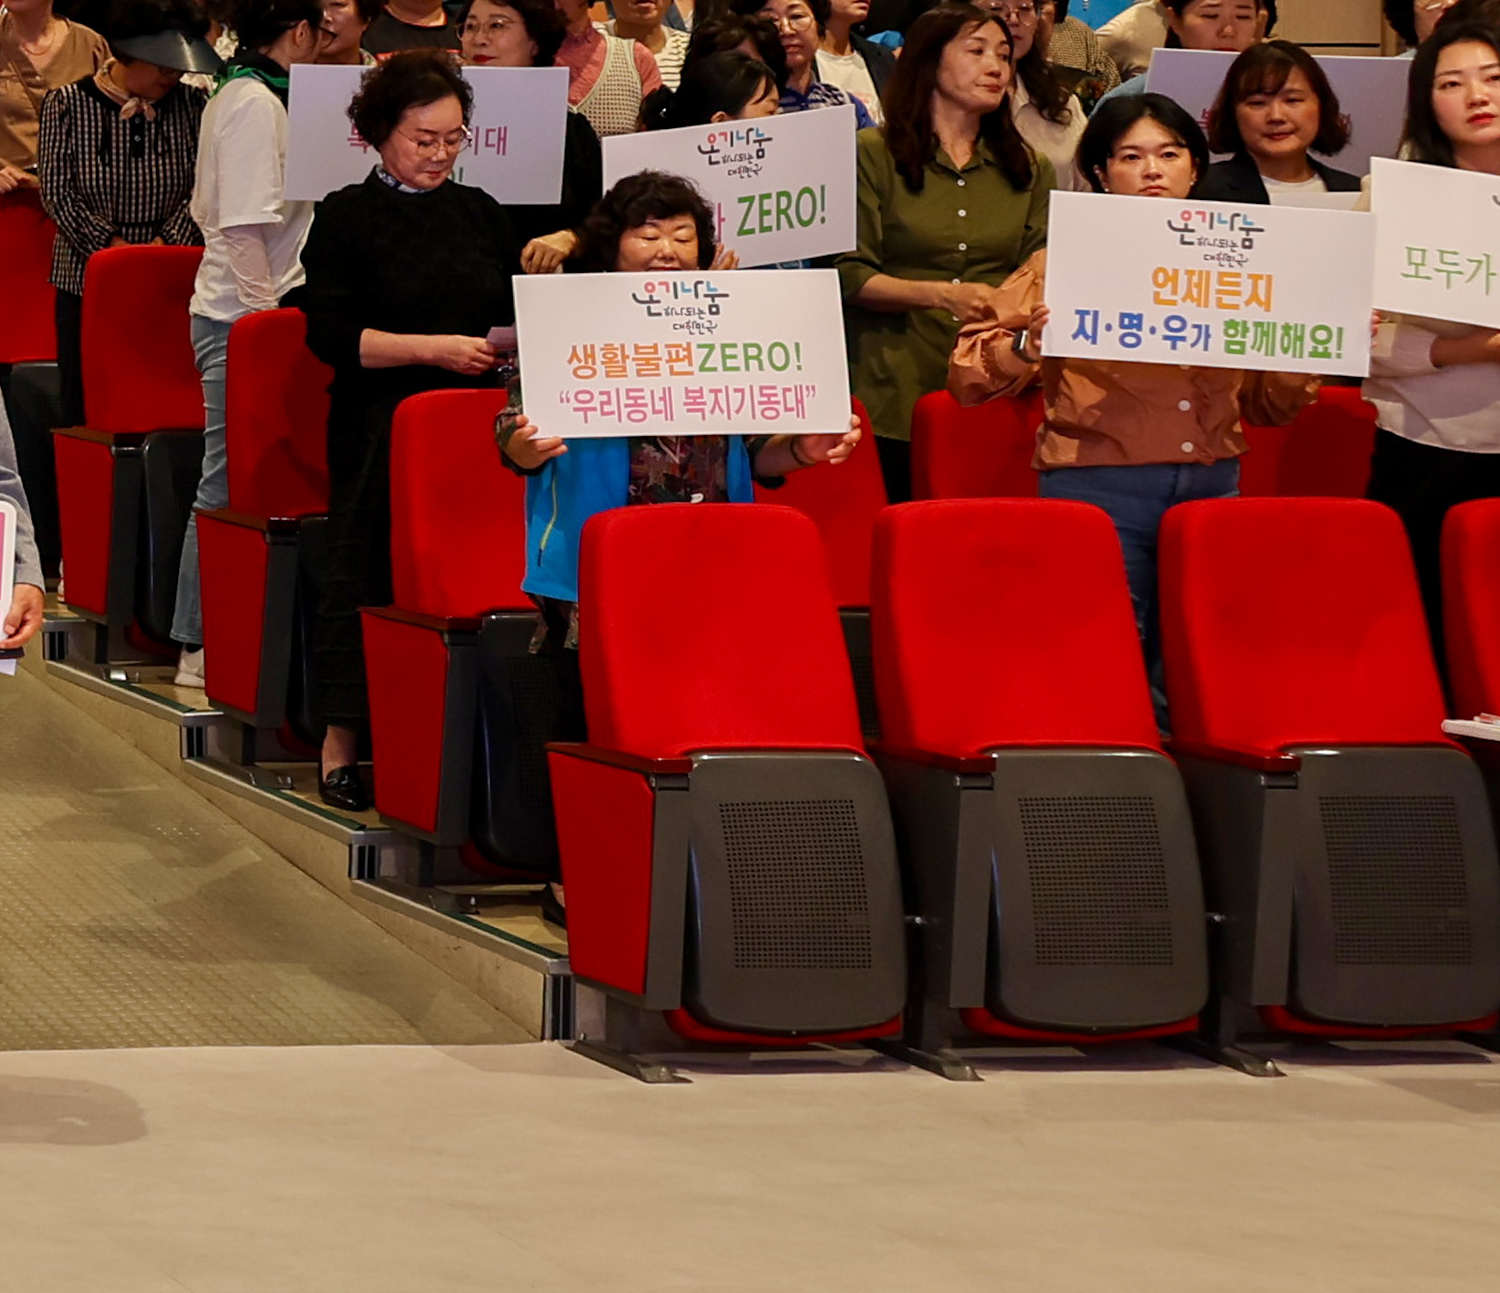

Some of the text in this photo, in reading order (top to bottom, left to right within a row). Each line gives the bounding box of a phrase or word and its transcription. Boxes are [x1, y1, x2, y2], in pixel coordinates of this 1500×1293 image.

[698, 127, 773, 166] 온기나눔
[737, 184, 827, 238] ZERO!
[1167, 210, 1265, 249] 온기나눔
[1151, 266, 1274, 312] 언제든지
[1400, 245, 1498, 296] 모두가
[632, 280, 729, 317] 온기나눔
[1222, 319, 1344, 359] 함께해요!
